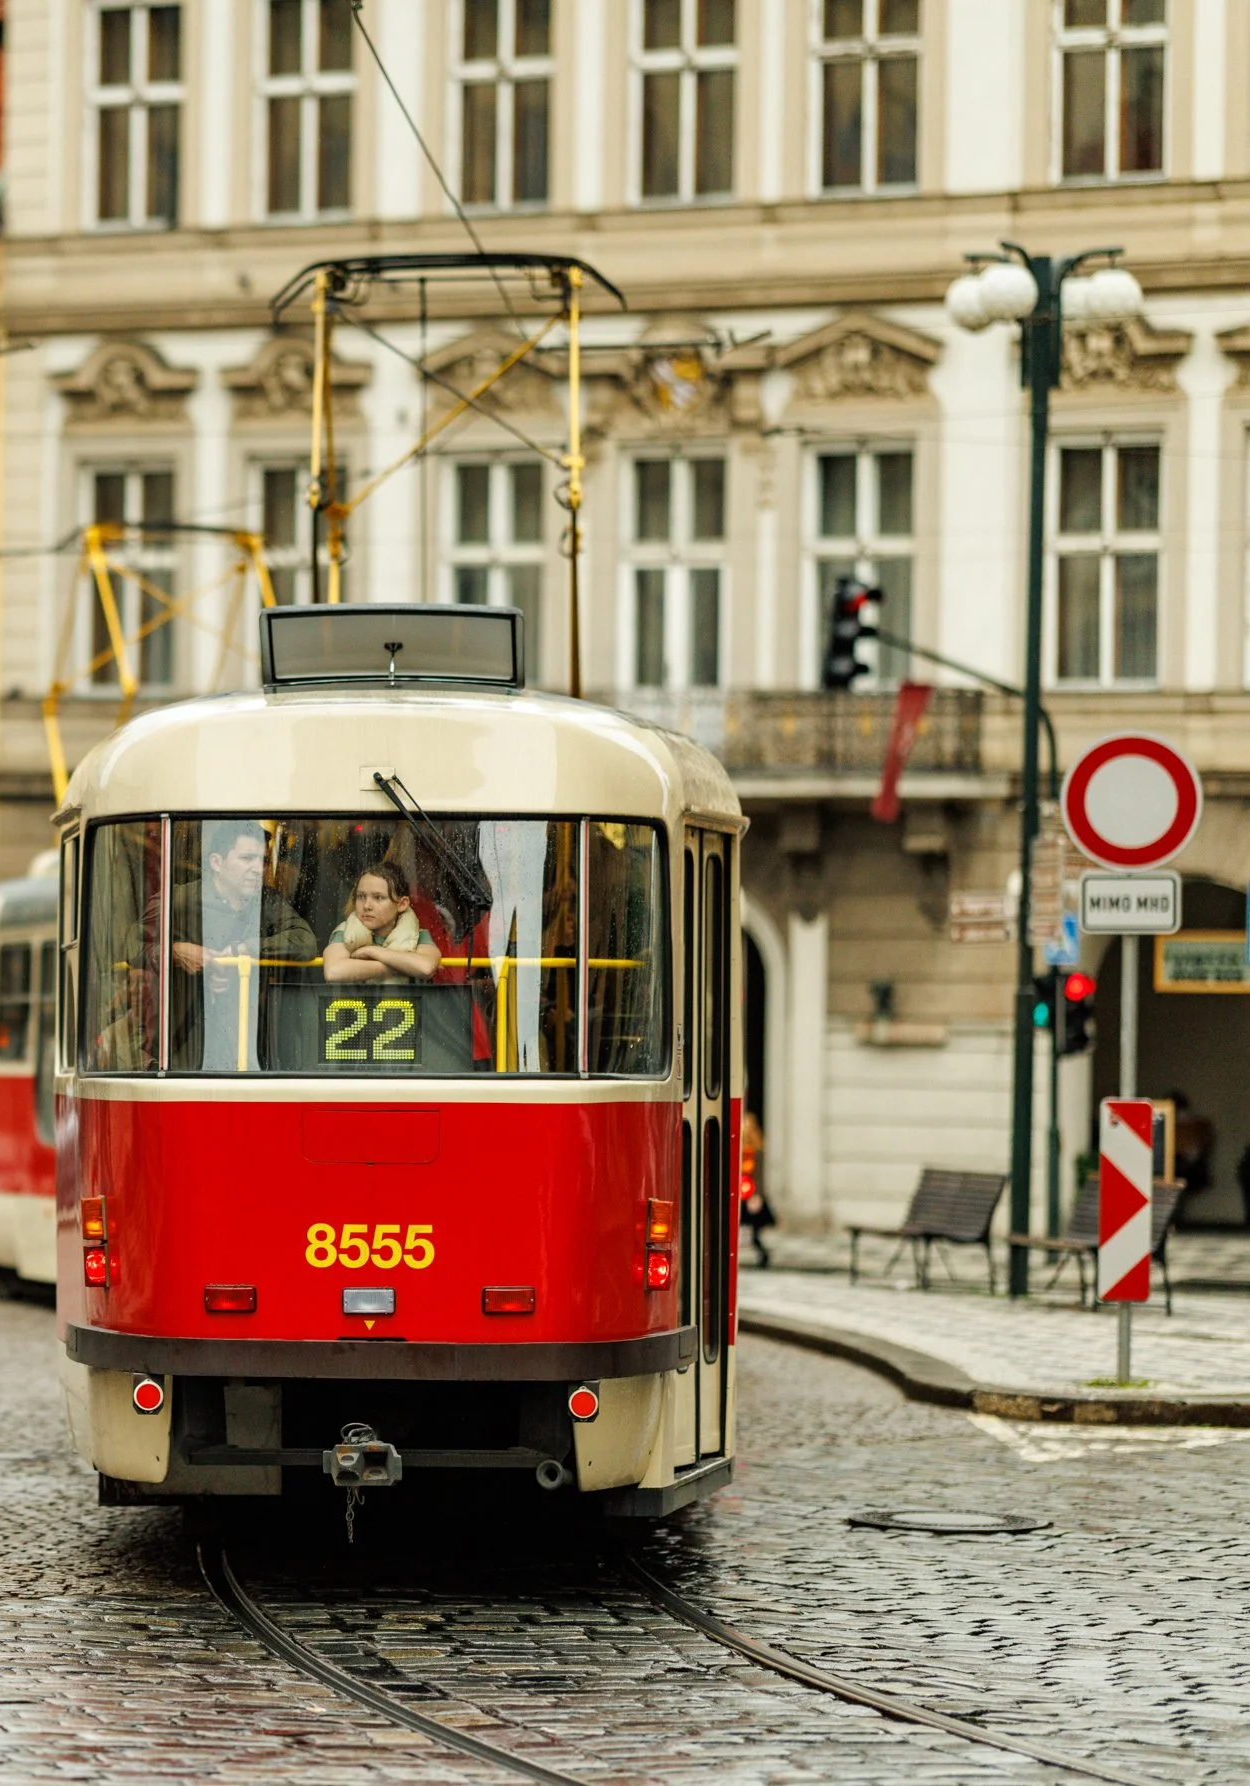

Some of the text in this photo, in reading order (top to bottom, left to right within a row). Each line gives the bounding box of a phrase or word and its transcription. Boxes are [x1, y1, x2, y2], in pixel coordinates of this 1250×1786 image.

[1090, 896, 1170, 913] MIMO MHD
[325, 1000, 415, 1060] 22
[305, 1223, 435, 1269] 8555
